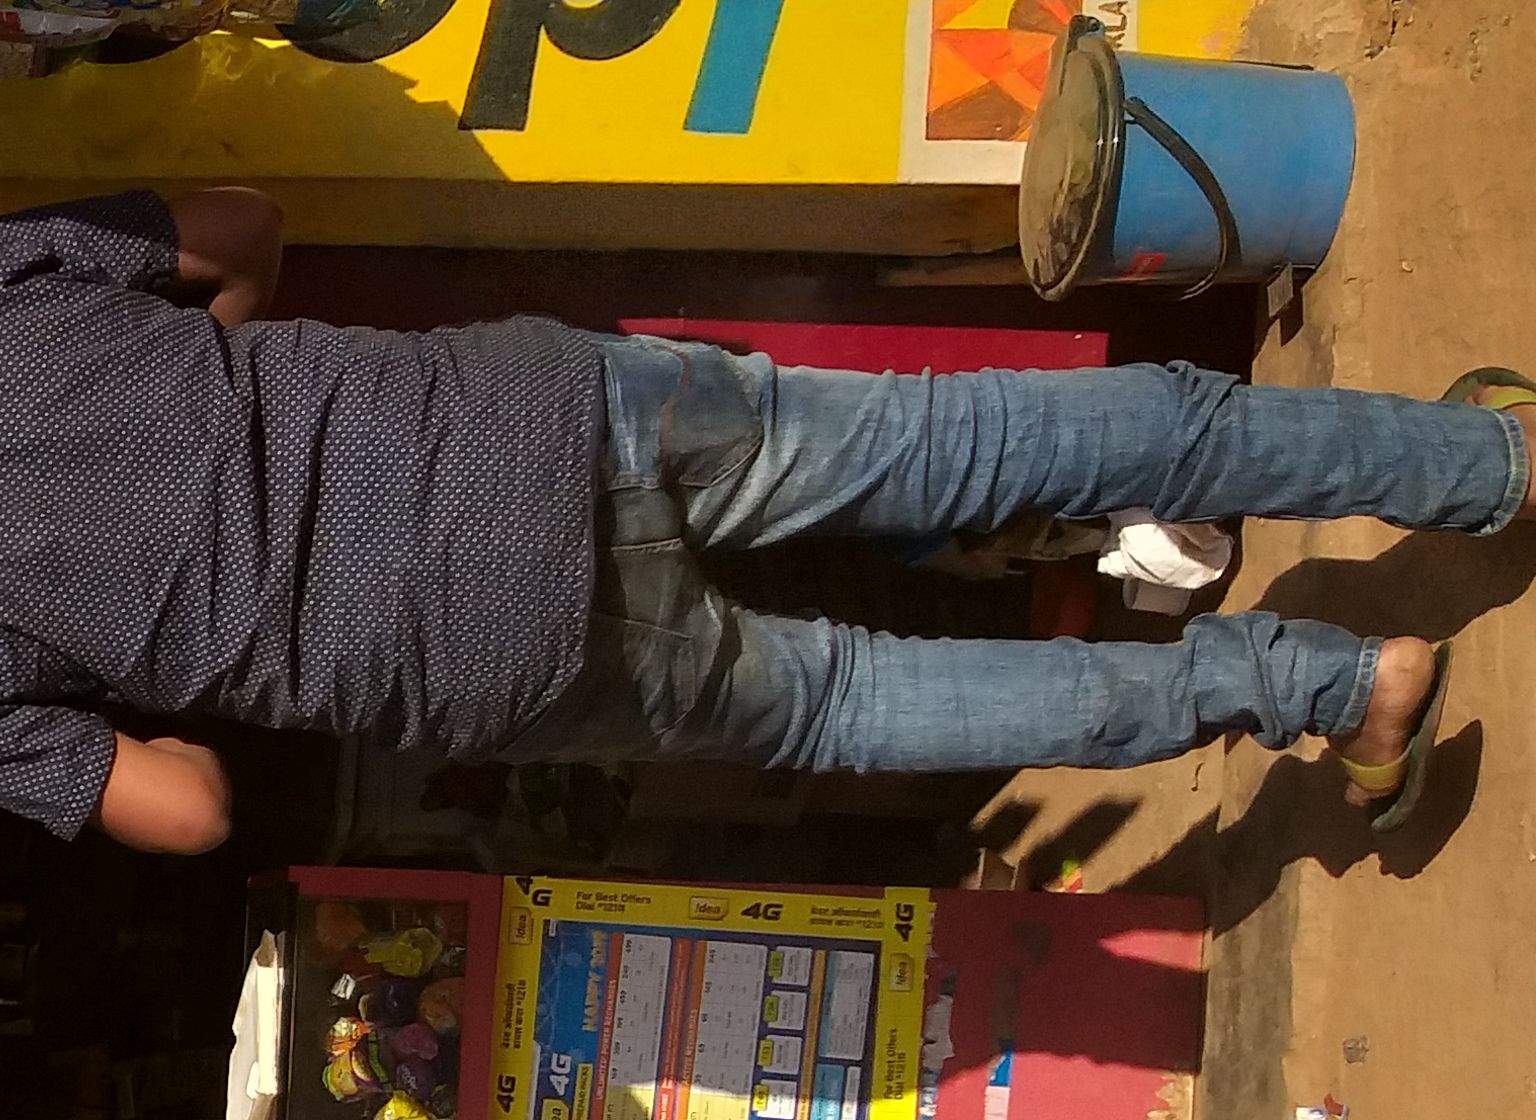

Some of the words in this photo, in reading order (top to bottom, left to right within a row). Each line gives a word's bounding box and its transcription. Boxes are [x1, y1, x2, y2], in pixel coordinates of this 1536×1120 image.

[740, 902, 783, 921] 4G
[894, 902, 915, 942] 4G
[548, 1052, 572, 1096] 4G
[884, 1058, 896, 1081] Best
[496, 1073, 516, 1113] 4G
[883, 1083, 895, 1100] For
[894, 1081, 905, 1100] Dial
